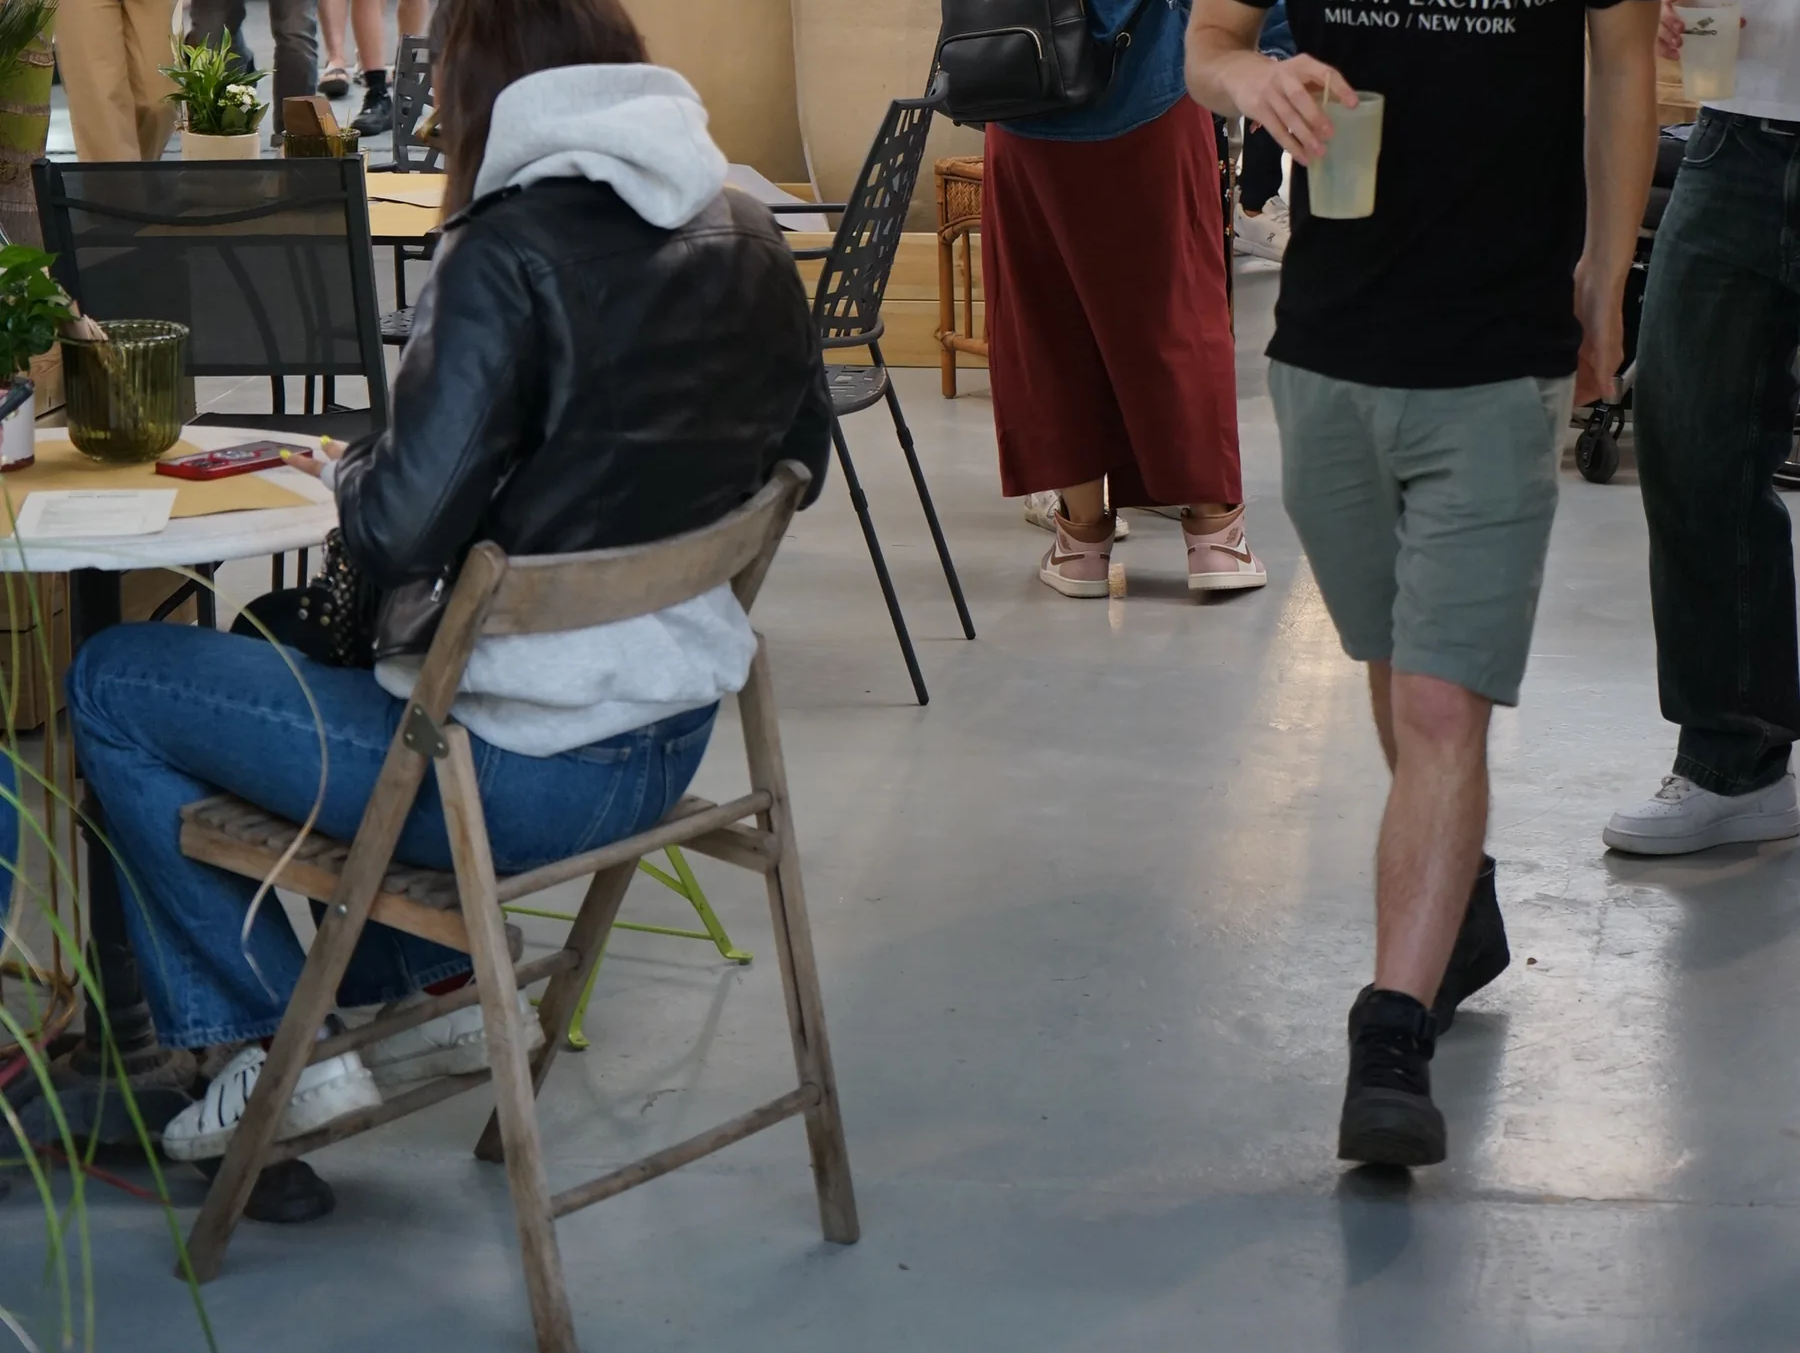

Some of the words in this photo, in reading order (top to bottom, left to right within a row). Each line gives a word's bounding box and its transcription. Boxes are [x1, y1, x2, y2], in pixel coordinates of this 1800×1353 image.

[1324, 7, 1400, 28] MILANO
[1405, 12, 1413, 29] /
[1418, 13, 1461, 32] NEW
[1464, 15, 1517, 34] YORK
